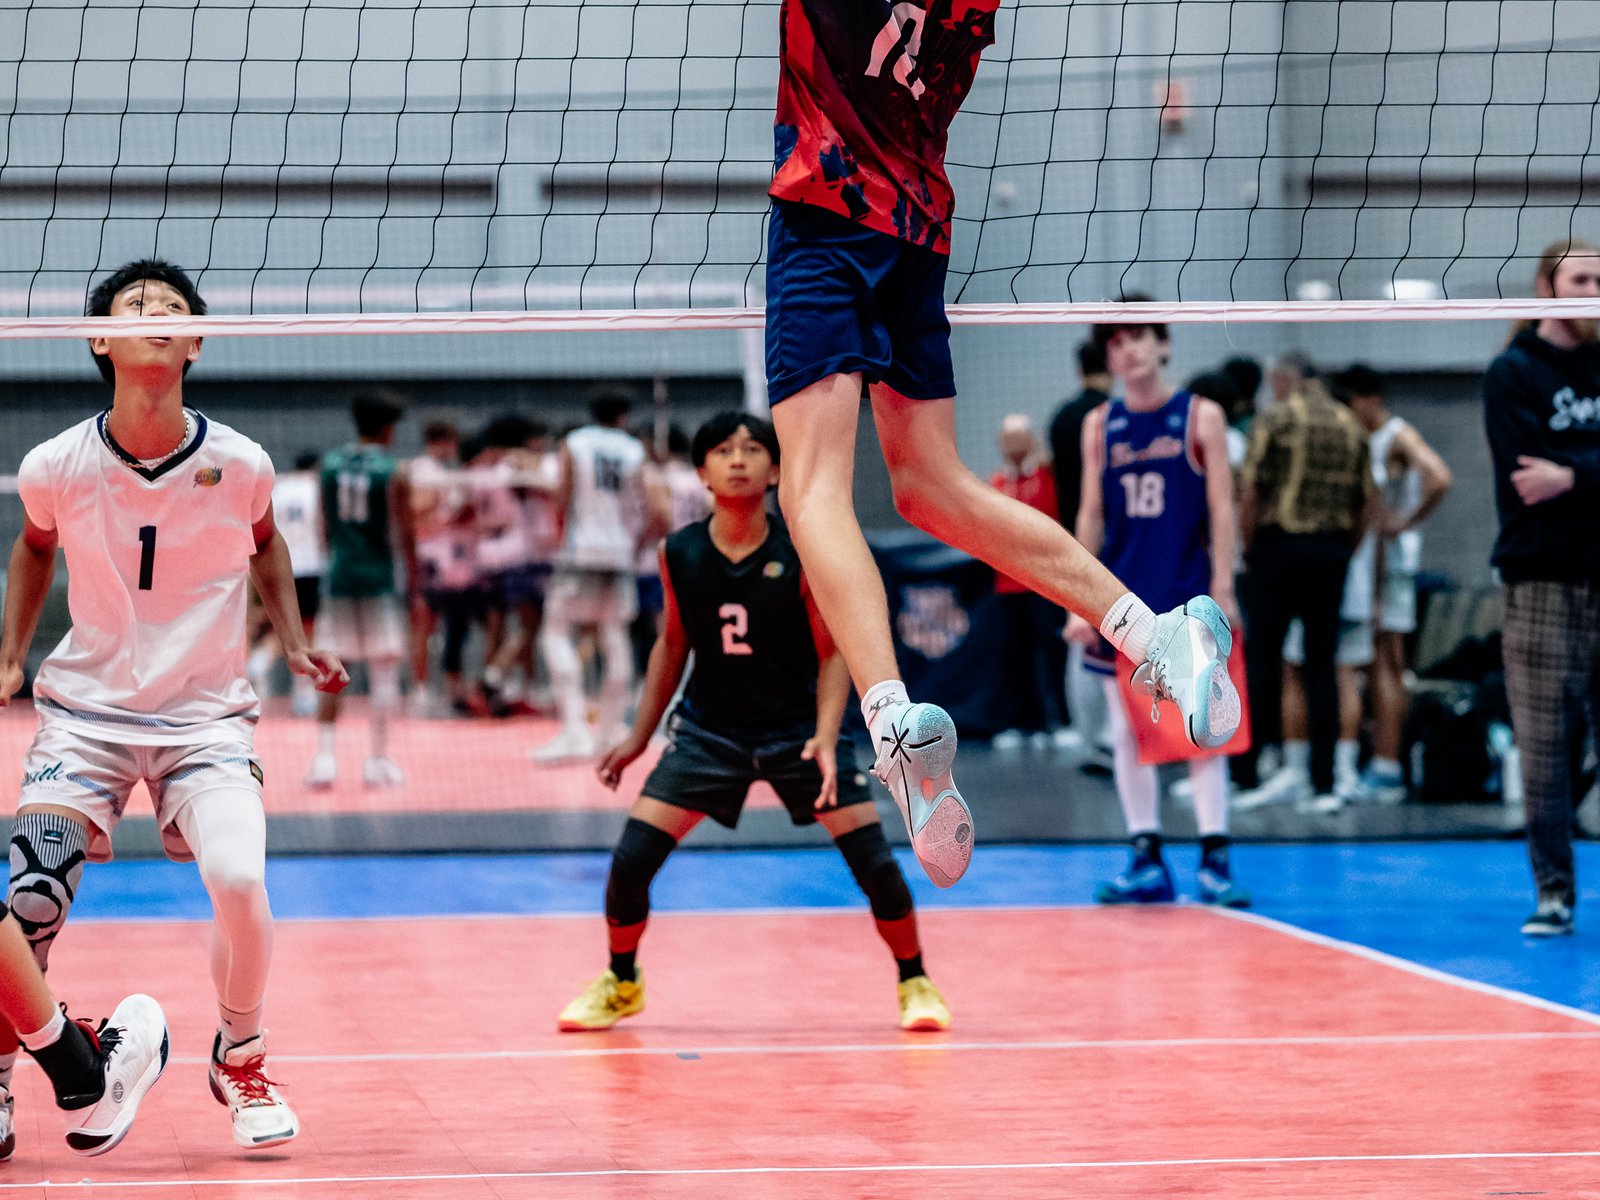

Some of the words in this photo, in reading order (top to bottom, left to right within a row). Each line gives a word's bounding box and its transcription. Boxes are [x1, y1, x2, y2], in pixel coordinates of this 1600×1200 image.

[1120, 471, 1165, 518] 18
[139, 525, 156, 590] 1
[719, 603, 753, 655] 2
